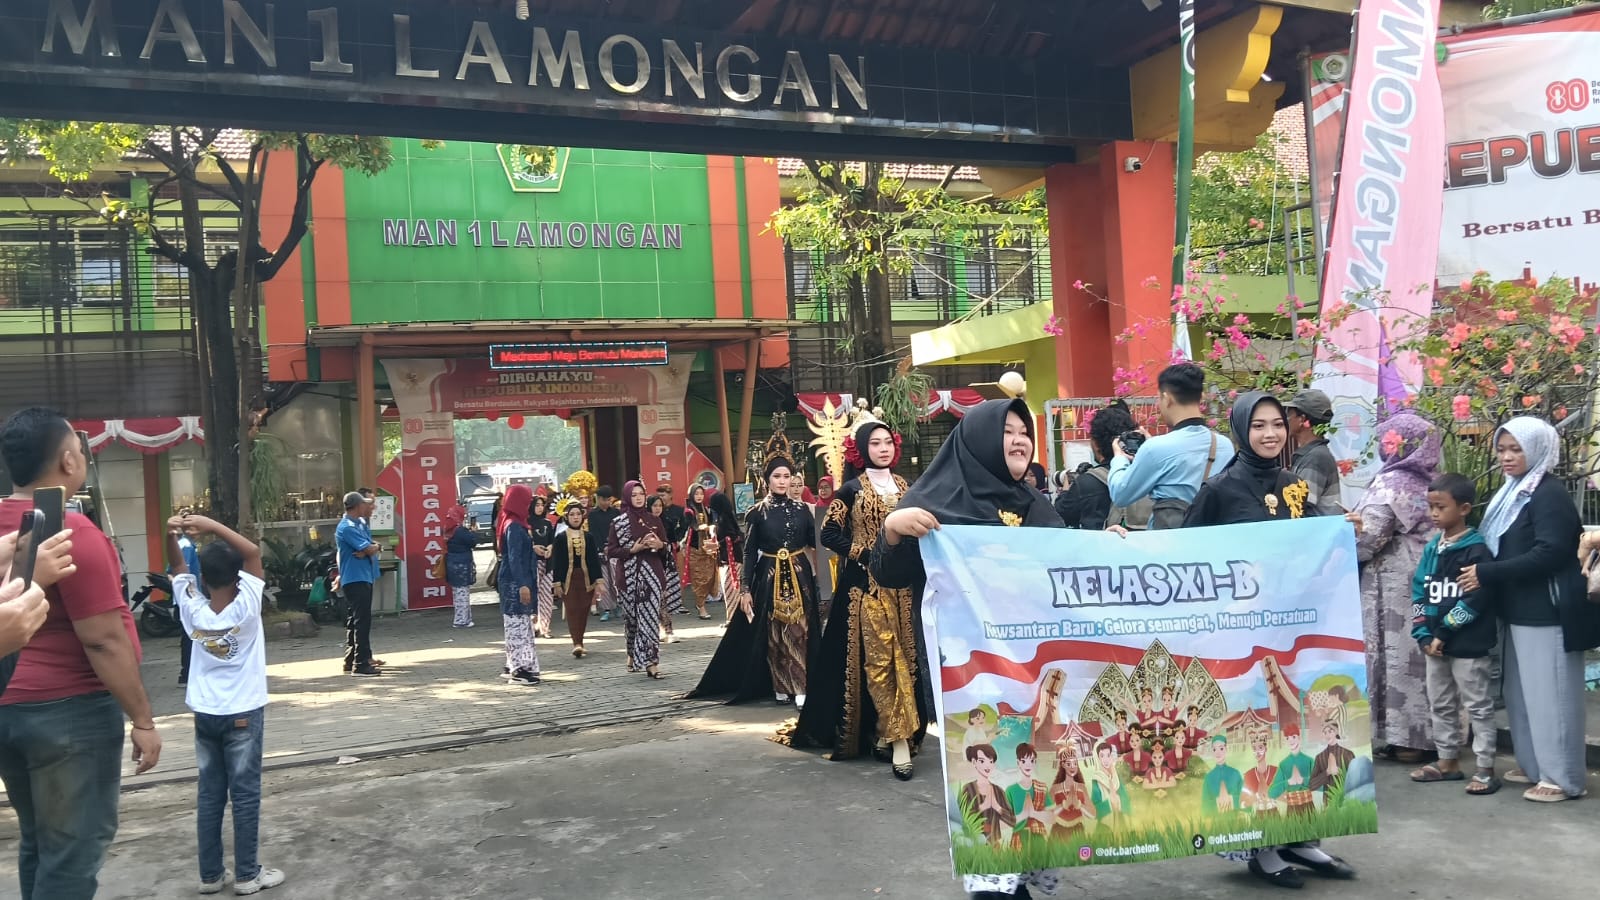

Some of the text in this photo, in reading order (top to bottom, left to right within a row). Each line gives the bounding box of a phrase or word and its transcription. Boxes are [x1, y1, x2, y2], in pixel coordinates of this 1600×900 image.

[40, 0, 868, 110] MAN 1 LAMONGAN
[1546, 78, 1590, 114] 80
[1443, 124, 1600, 191] EPUB
[383, 218, 683, 249] MAN 1 LAMONGAN
[1462, 216, 1573, 239] Bersatu
[499, 371, 593, 384] DIRGAHAYU
[423, 585, 446, 598] RI
[1047, 560, 1260, 608] KELAS XI-B
[1060, 619, 1095, 638] Baru
[1104, 617, 1146, 637] Gelora
[1147, 614, 1215, 633] semangat,
[1217, 611, 1263, 630] Menuju
[1263, 608, 1318, 627] Persatuan
